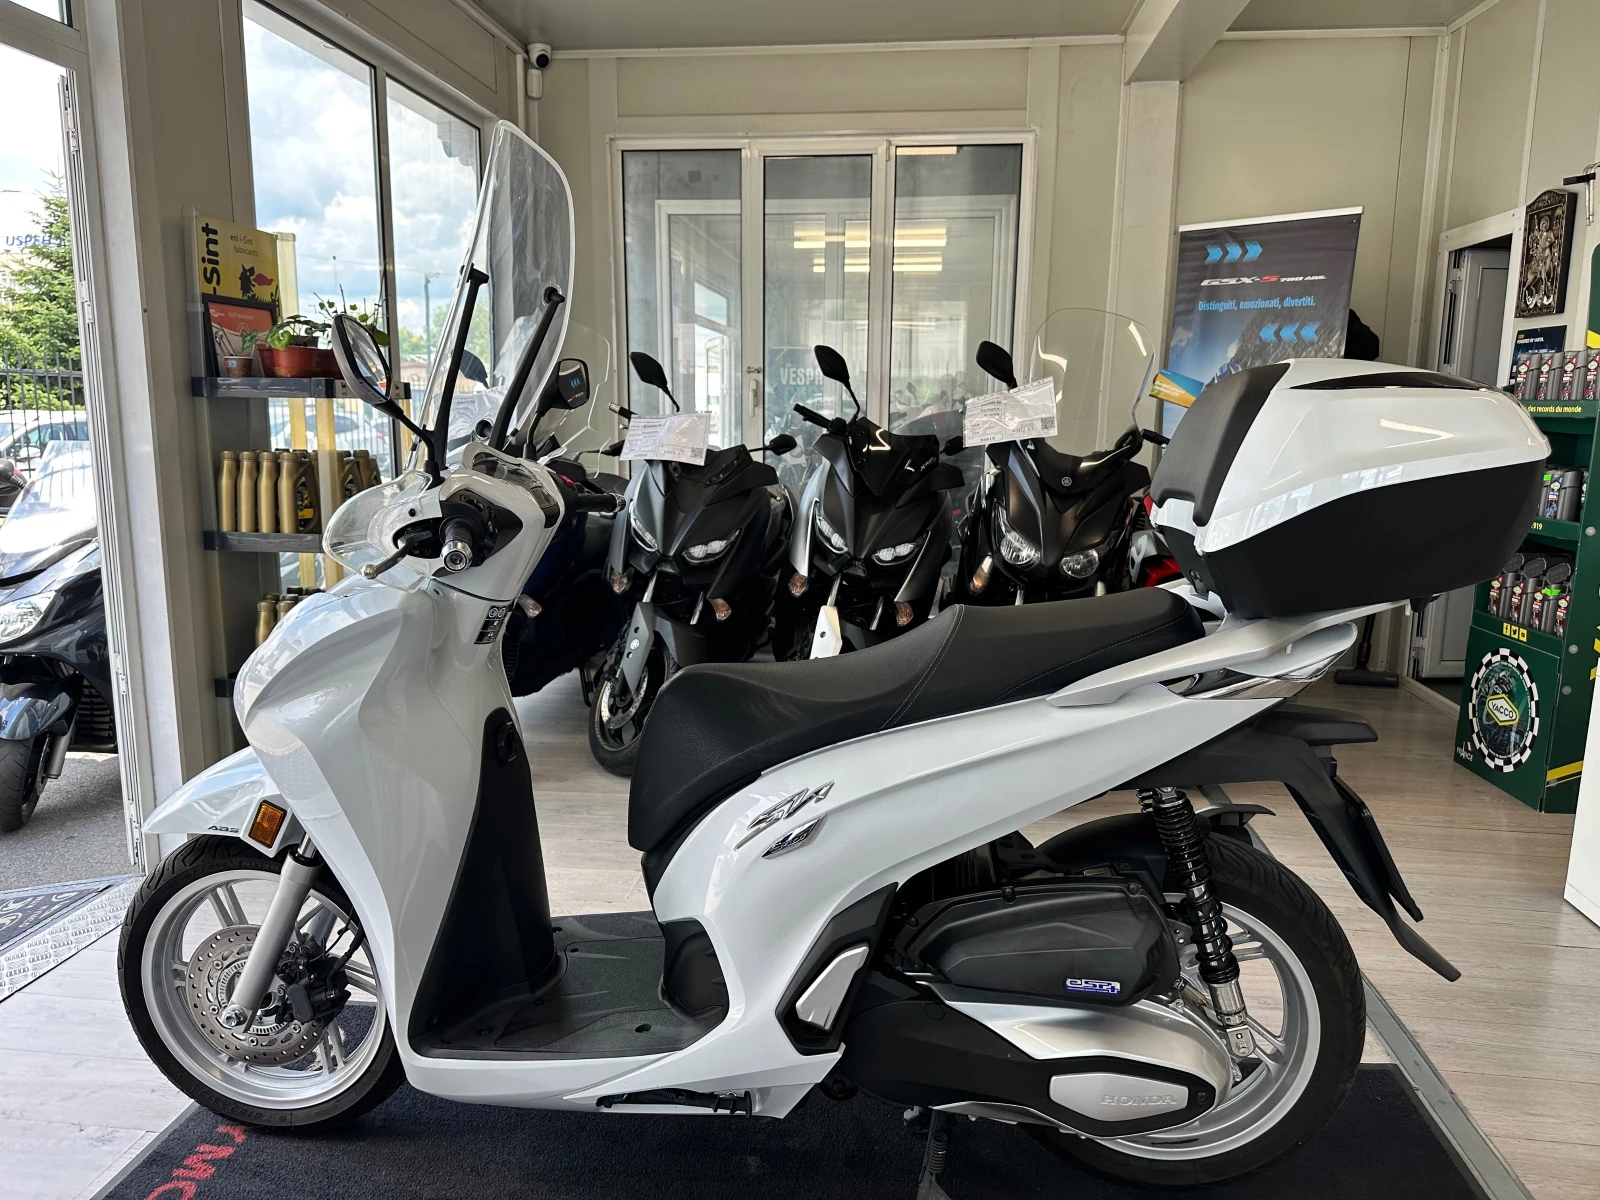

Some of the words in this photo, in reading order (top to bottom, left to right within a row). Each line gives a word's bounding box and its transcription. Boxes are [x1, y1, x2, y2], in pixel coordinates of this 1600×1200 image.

[233, 244, 259, 257] lubricants
[1198, 301, 1238, 312] Distinguiti,
[1240, 298, 1281, 309] emozionati,
[1283, 296, 1316, 307] divertiti.
[780, 367, 823, 385] VESPA
[1537, 405, 1555, 413] records
[1530, 521, 1543, 530] 919
[1490, 702, 1514, 719] YACCO
[208, 825, 240, 833] ABS
[1100, 1094, 1178, 1106] HONDA
